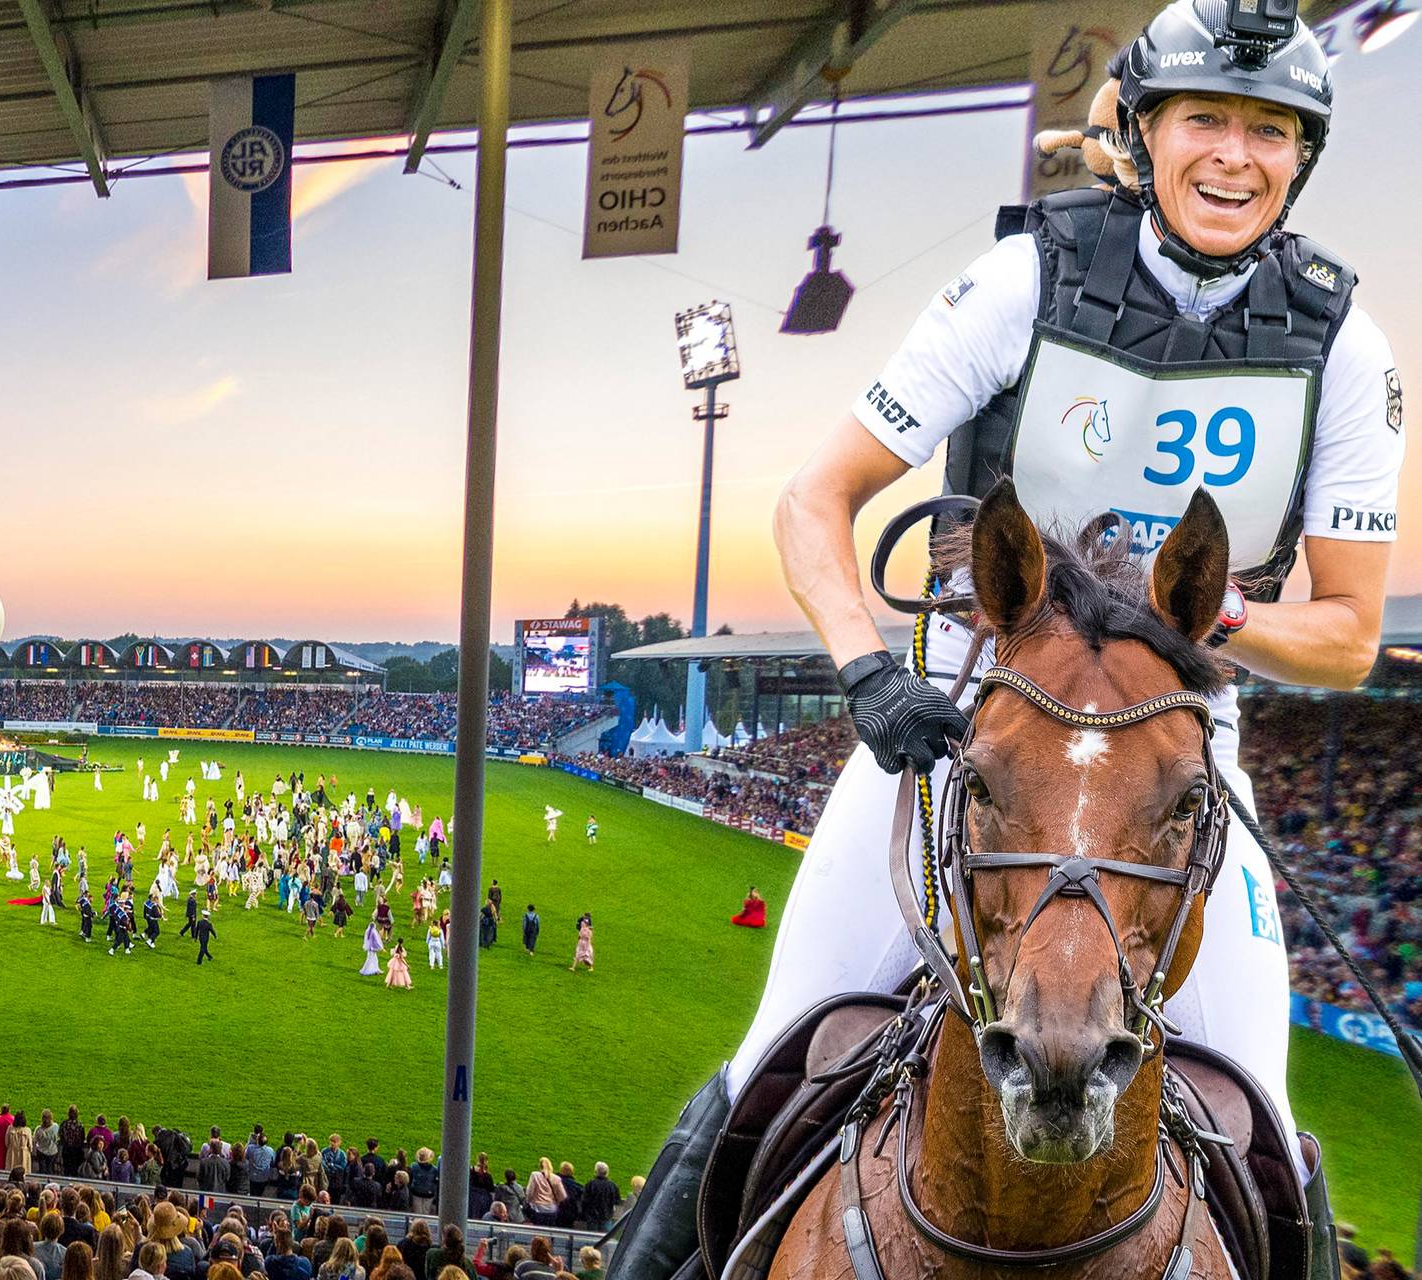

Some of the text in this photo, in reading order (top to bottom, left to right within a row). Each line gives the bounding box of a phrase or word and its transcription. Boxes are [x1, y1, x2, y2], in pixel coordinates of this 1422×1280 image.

[1160, 50, 1206, 69] uvex
[1289, 64, 1323, 93] uvex
[866, 381, 922, 434] ENDT
[1143, 406, 1256, 487] 39
[542, 620, 582, 629] STAWAG
[390, 739, 407, 748] JETZT
[409, 740, 423, 749] PATE
[453, 1065, 468, 1102] A
